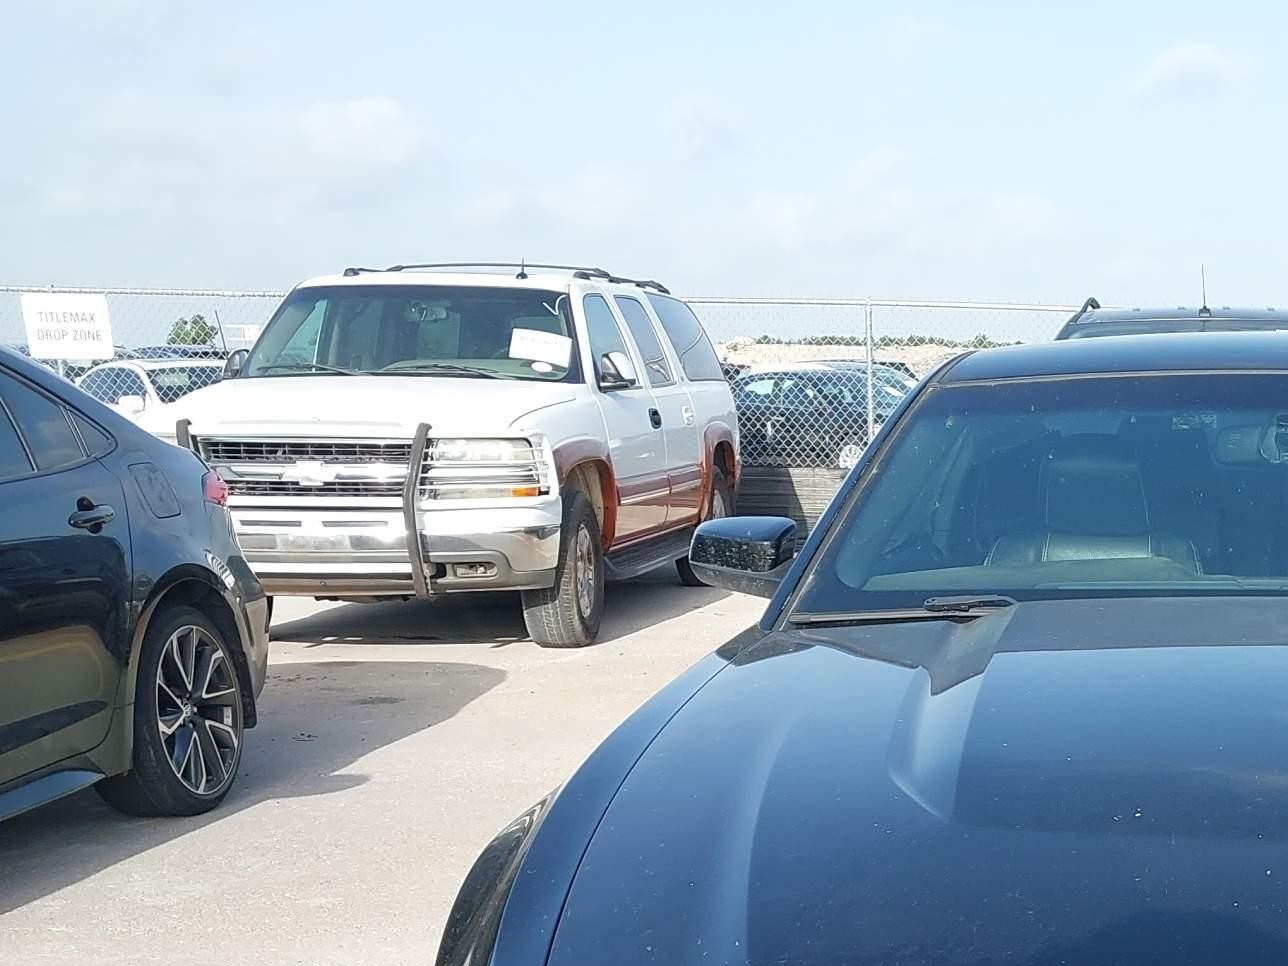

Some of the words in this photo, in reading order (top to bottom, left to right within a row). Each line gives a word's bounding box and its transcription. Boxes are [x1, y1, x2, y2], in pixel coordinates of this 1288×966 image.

[36, 311, 96, 323] TITLEMAX
[36, 328, 69, 341] DROP
[72, 329, 102, 341] ZONE
